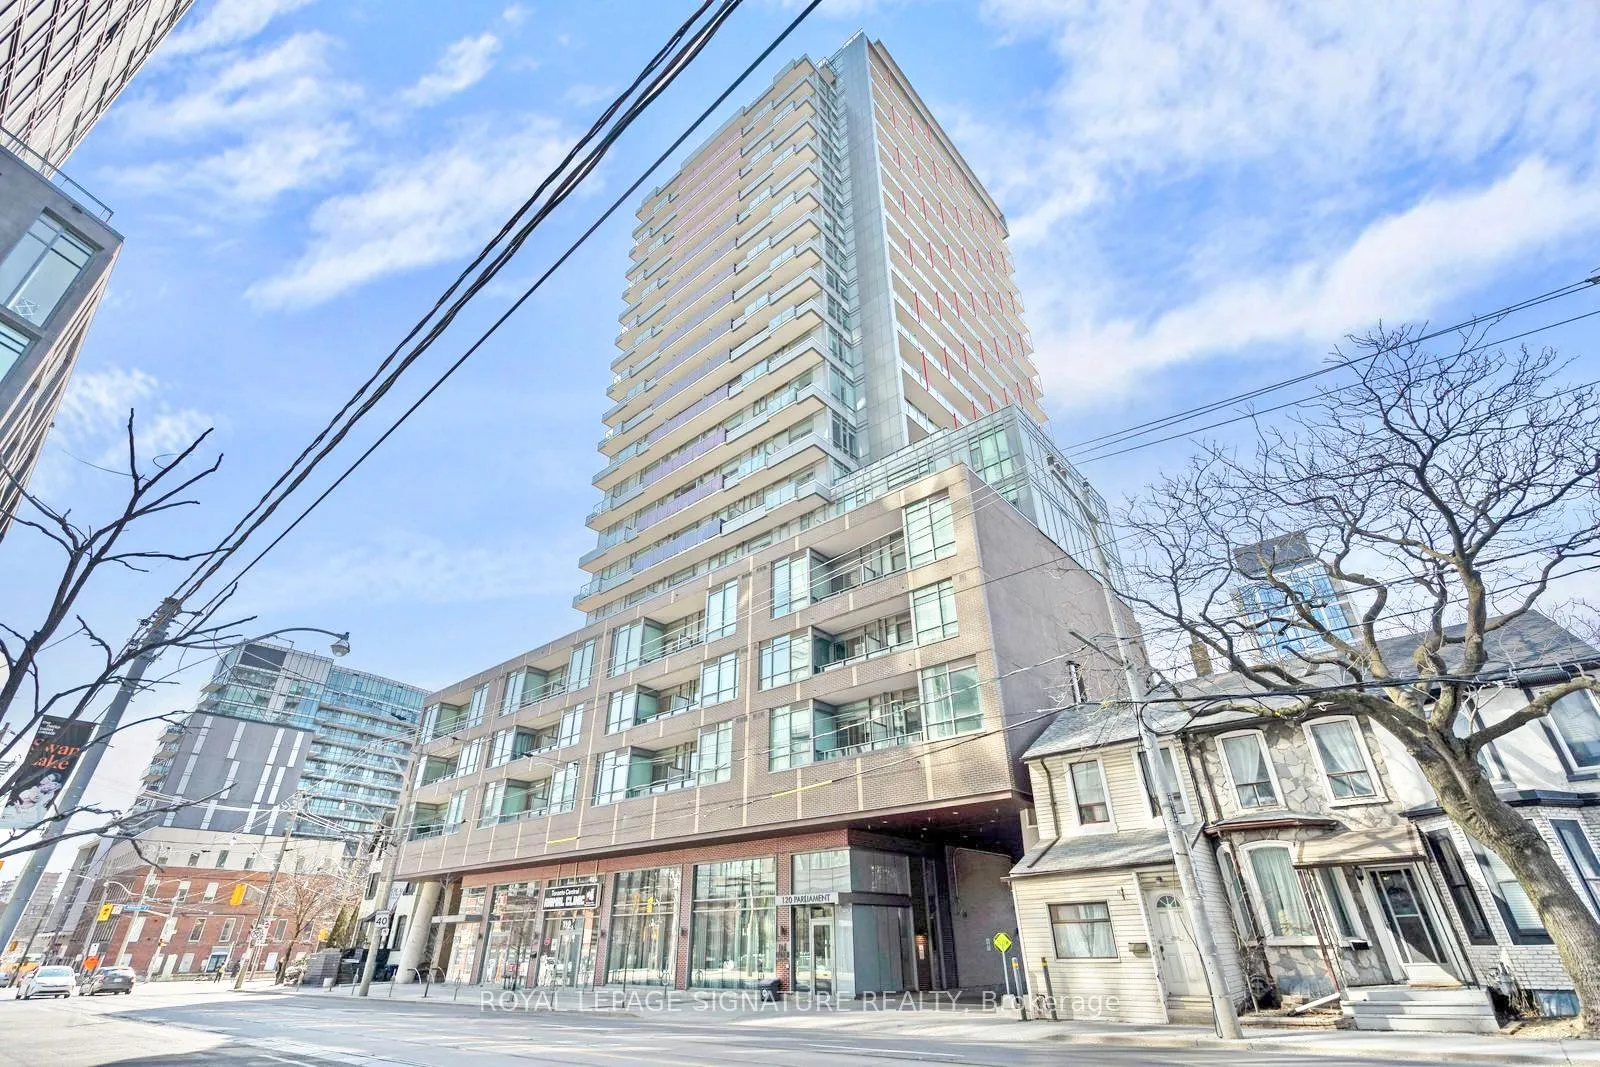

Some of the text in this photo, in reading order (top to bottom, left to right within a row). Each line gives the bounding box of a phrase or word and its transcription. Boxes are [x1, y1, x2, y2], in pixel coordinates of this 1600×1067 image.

[32, 754, 69, 770] ake
[782, 894, 831, 904] 120 PARLIAMENT
[375, 917, 388, 926] 40
